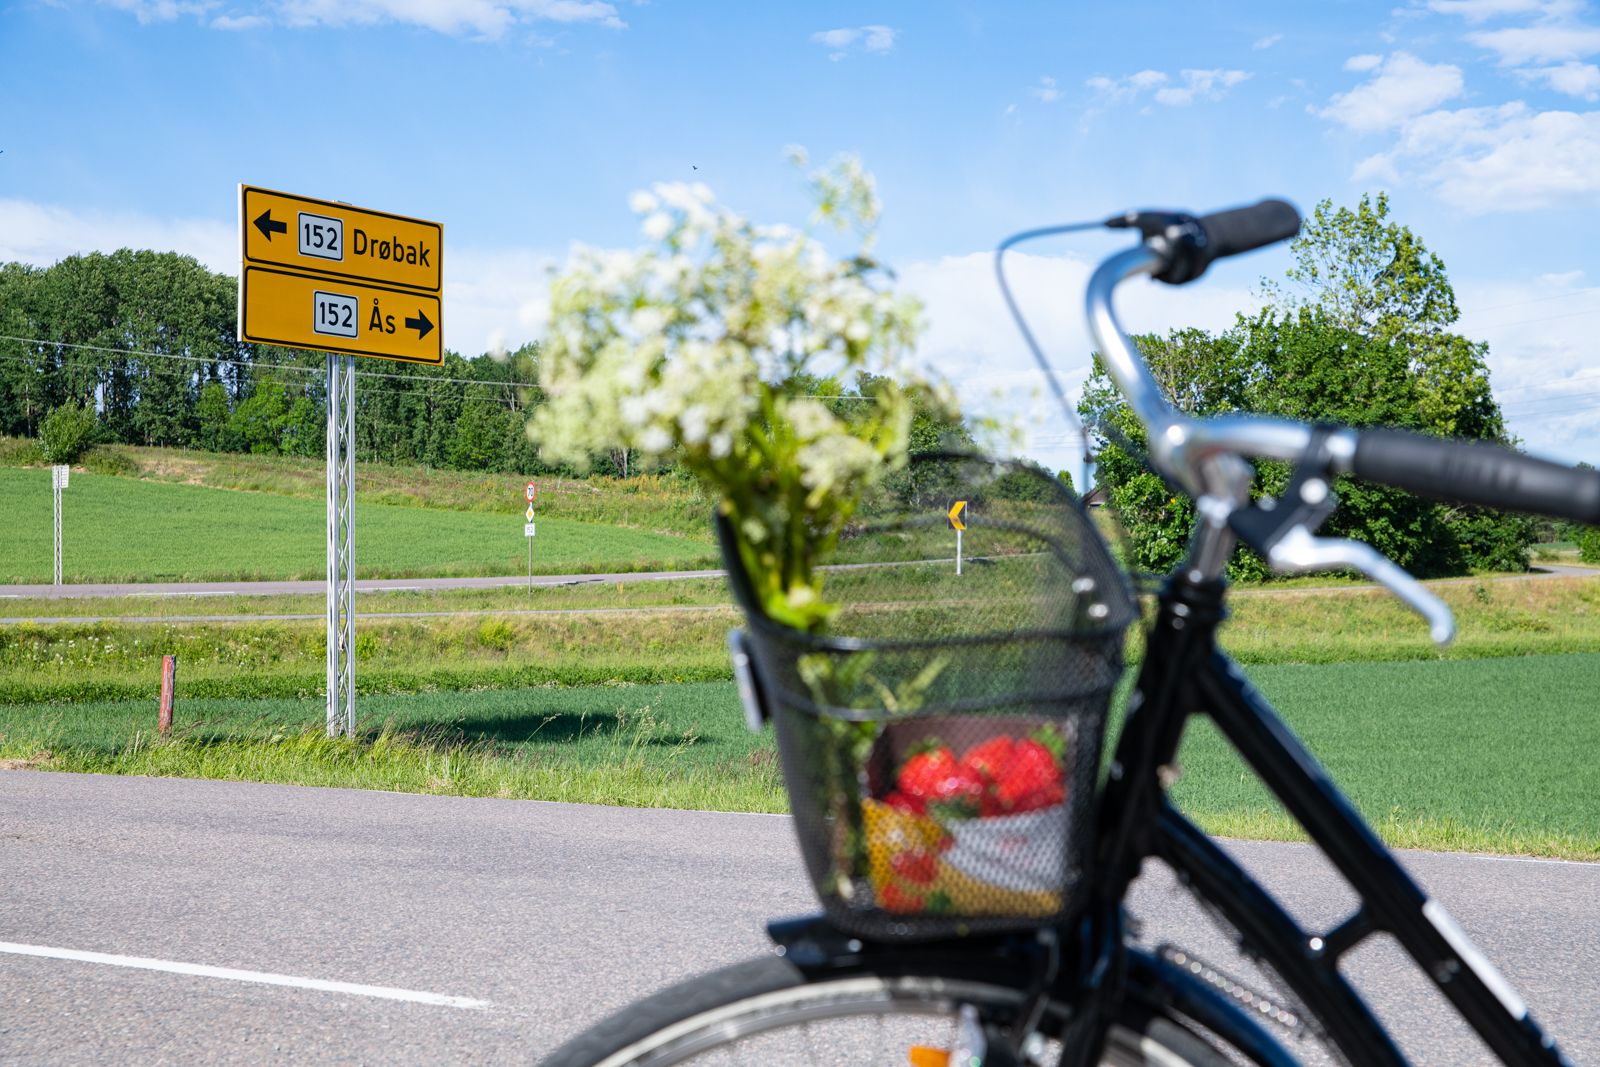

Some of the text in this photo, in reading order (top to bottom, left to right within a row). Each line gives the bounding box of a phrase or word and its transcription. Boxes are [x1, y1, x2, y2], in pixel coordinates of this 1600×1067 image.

[304, 223, 431, 268] 152 Drøbak
[320, 298, 396, 334] 152 Ås
